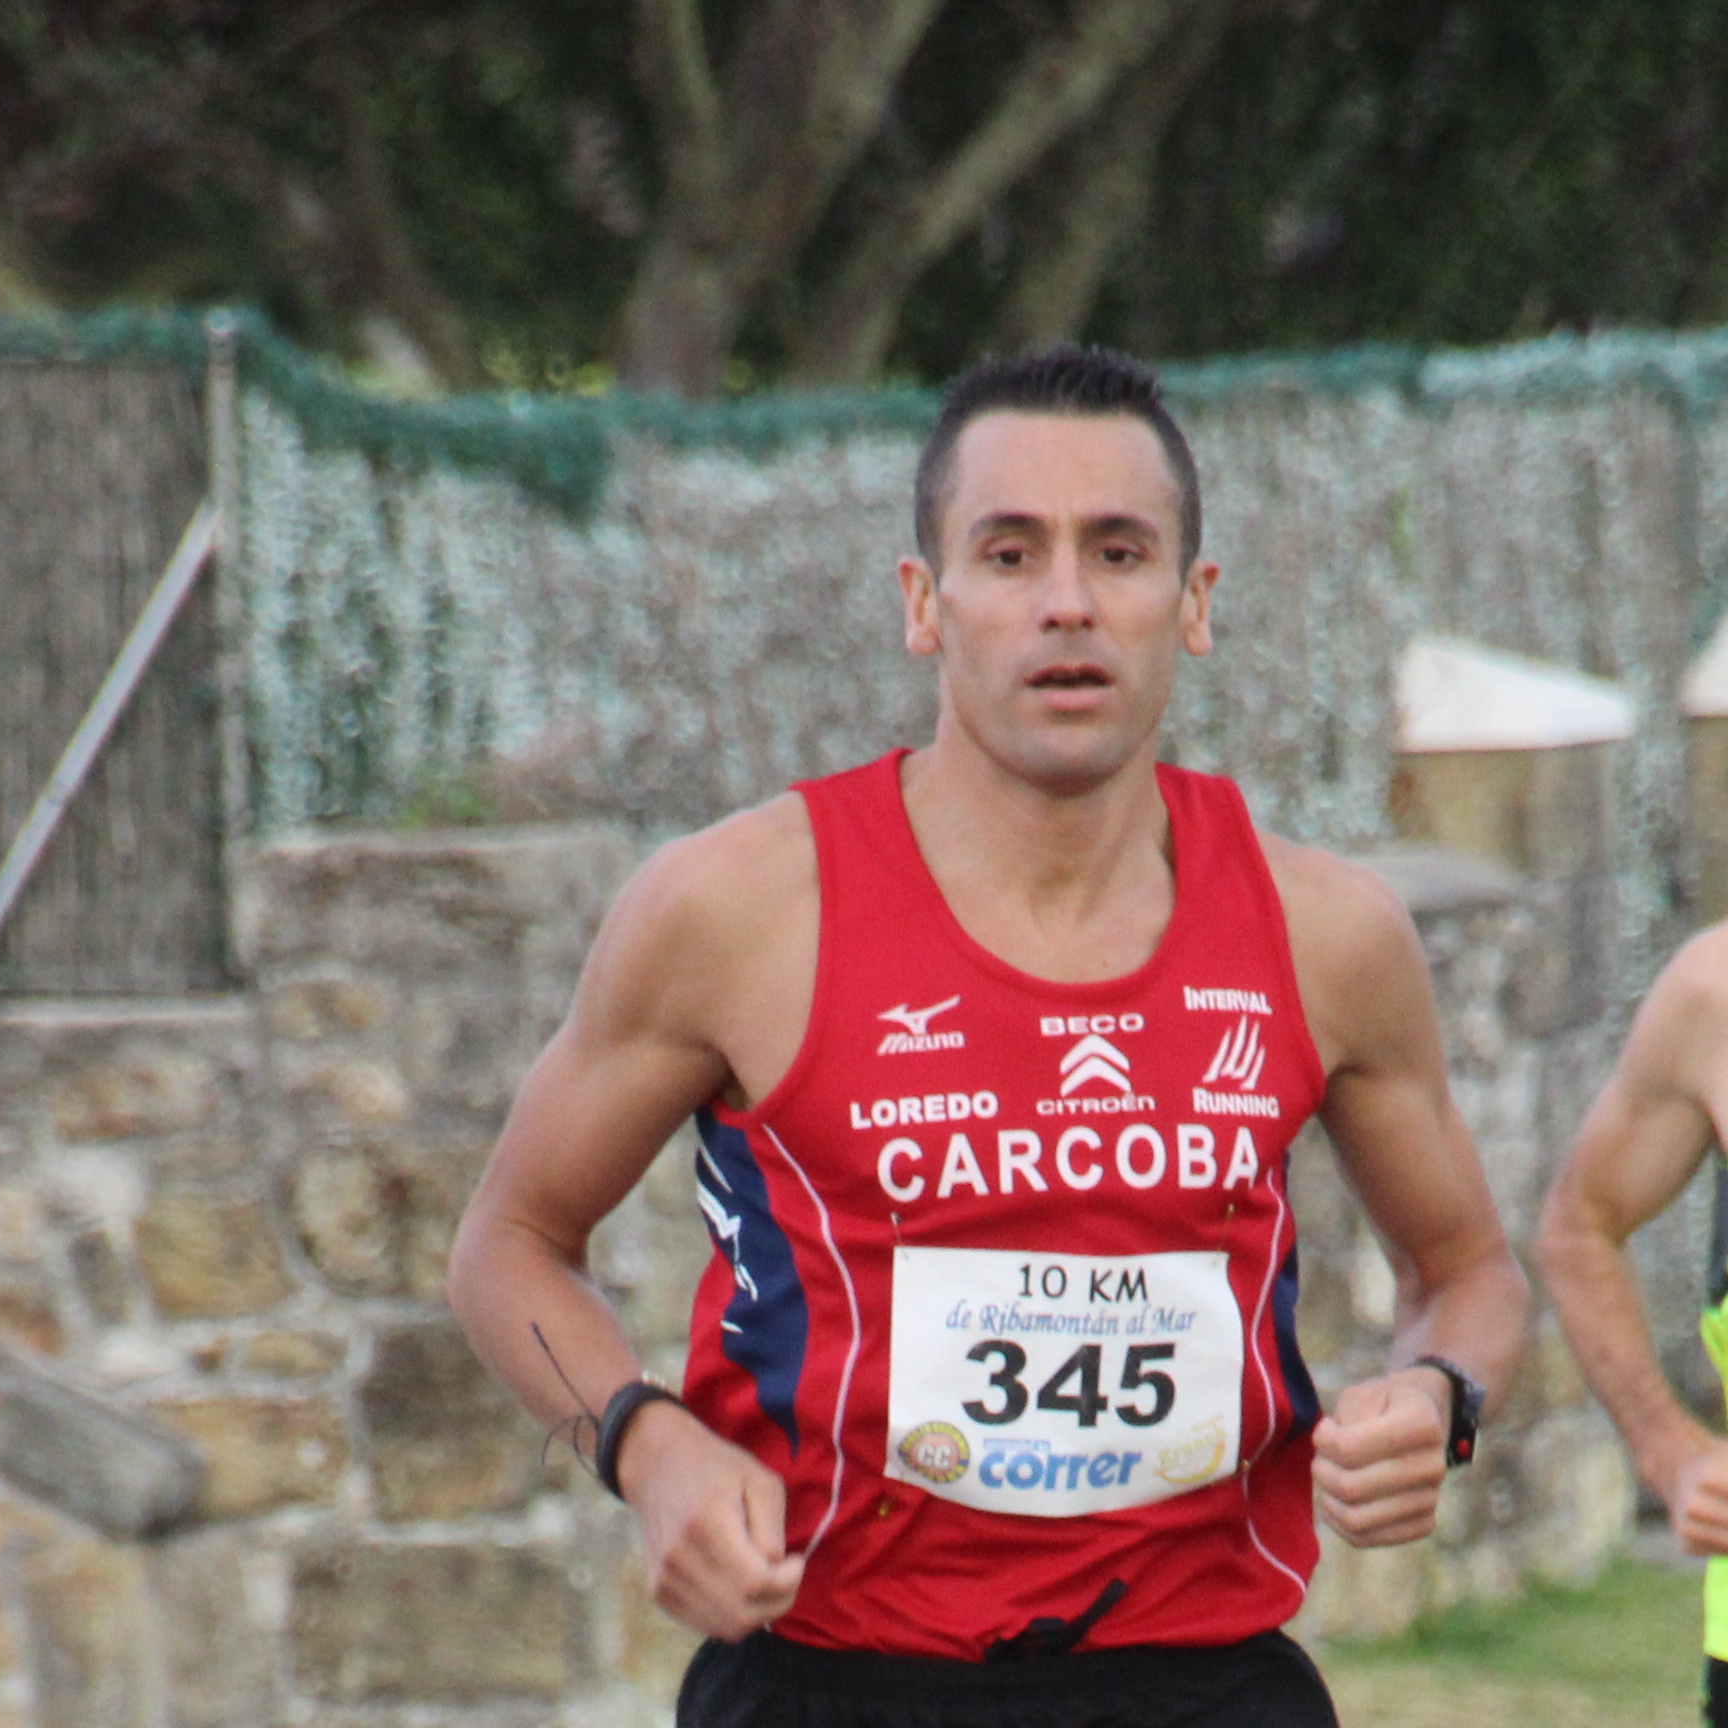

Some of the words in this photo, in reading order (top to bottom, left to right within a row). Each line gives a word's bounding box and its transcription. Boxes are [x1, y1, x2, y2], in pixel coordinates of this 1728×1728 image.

[1183, 986, 1272, 1015] INTERVAL
[1040, 1013, 1144, 1036] BECO
[850, 1090, 998, 1130] LOREDO
[1192, 1087, 1280, 1119] RUNNING
[877, 1124, 1259, 1203] CARCOBA
[1018, 1264, 1067, 1299] 10
[1089, 1268, 1149, 1304] KM
[946, 1300, 971, 1330] de
[1126, 1303, 1145, 1334] al
[1151, 1310, 1199, 1335] Mar
[962, 1339, 1177, 1428] 345
[979, 1449, 1143, 1491] correr
